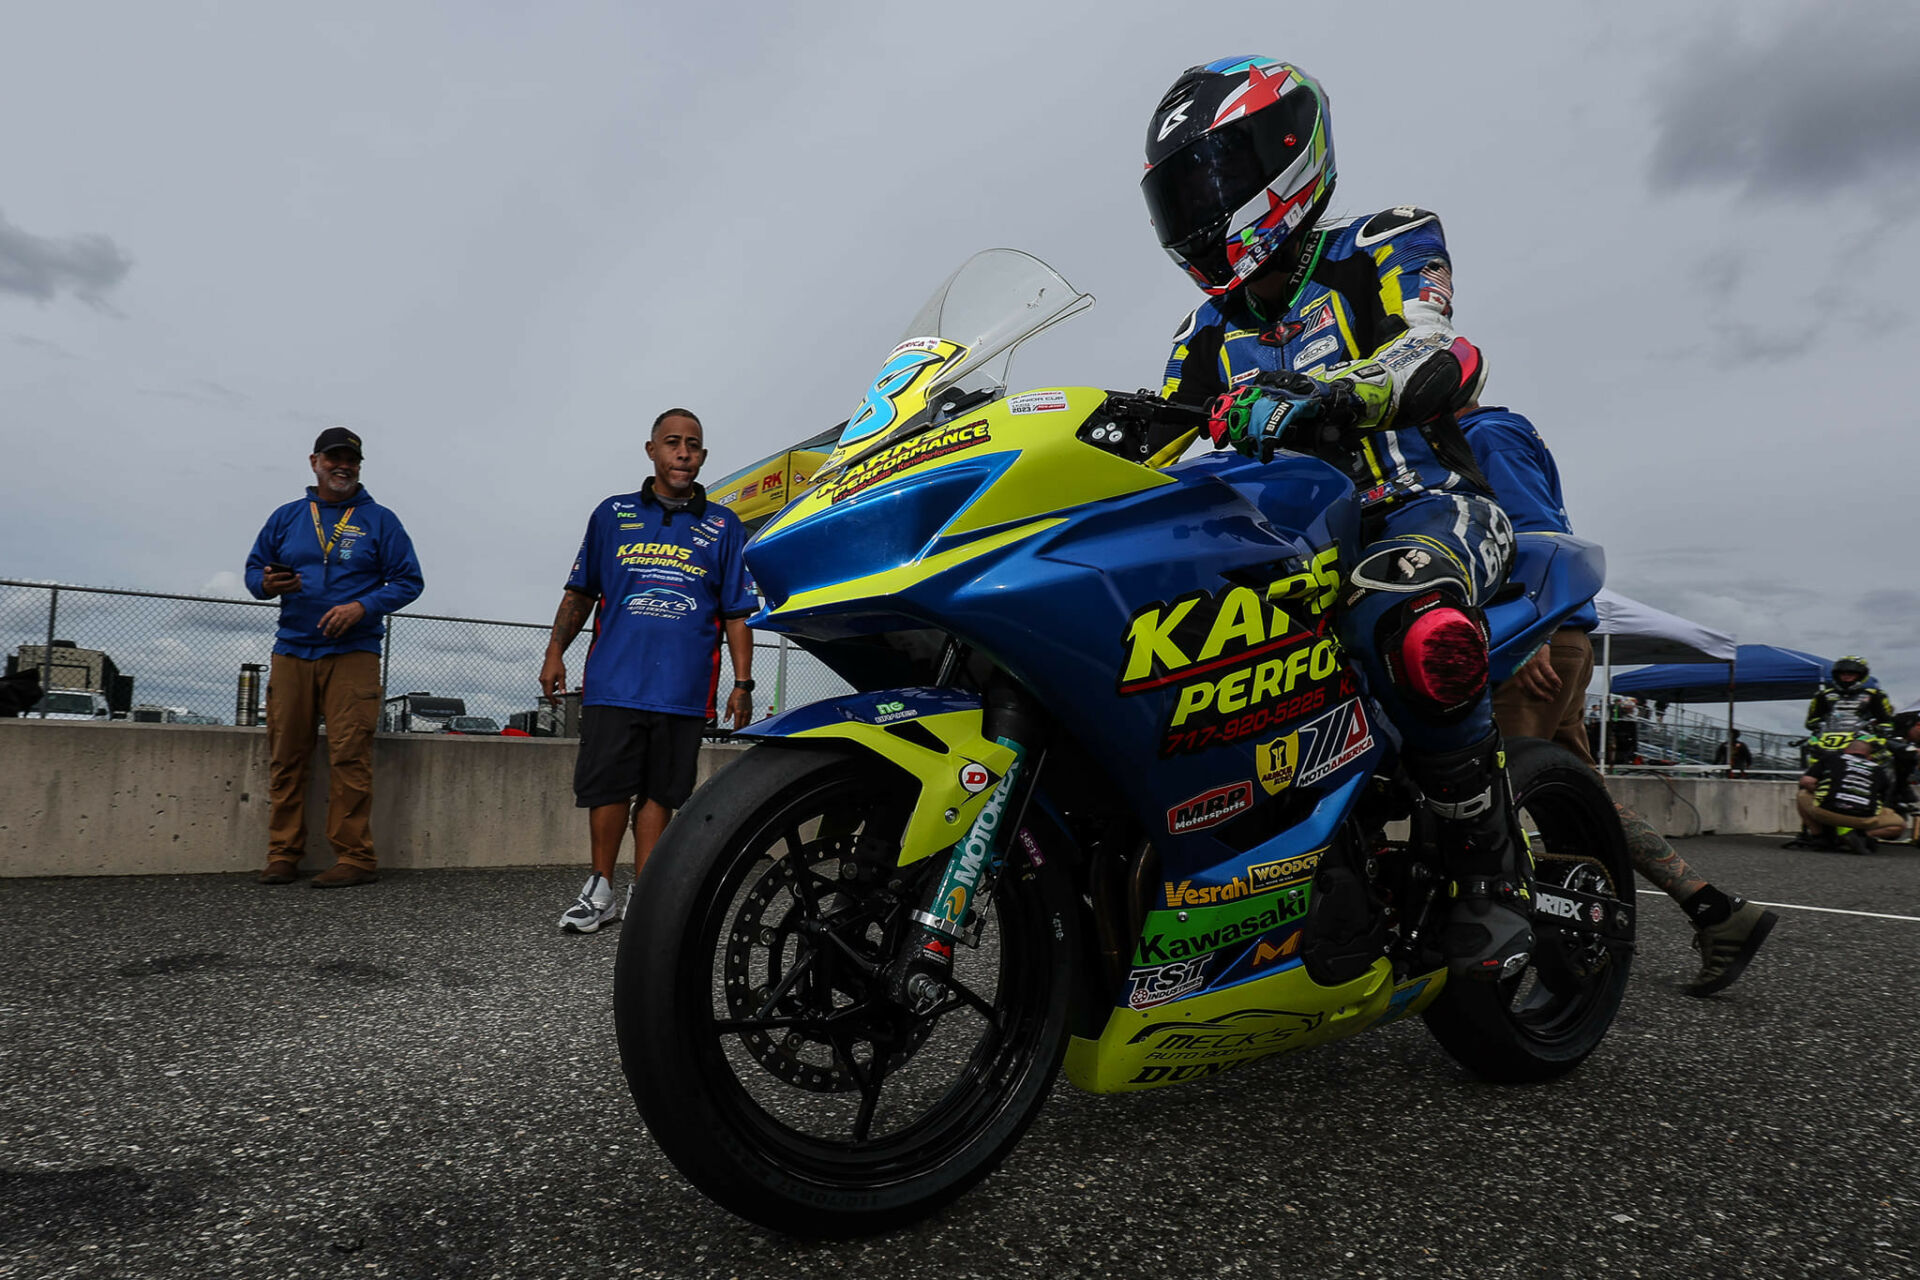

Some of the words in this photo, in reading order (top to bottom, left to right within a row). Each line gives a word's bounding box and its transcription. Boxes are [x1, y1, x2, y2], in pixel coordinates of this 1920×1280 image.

[1011, 406, 1032, 414] 2023
[1265, 401, 1291, 433] BISON
[833, 423, 988, 498] PERFORMANCE
[761, 470, 784, 492] RK
[615, 542, 693, 560] KARNS
[620, 556, 708, 578] PERFORMANCE
[628, 598, 689, 612] MECK'S
[1167, 686, 1326, 753] 717-920-5225
[1261, 765, 1293, 782] ARMOUR
[1300, 738, 1374, 787] MOTOAMERICA
[1175, 800, 1247, 830] Motorsports
[1176, 787, 1246, 823] MRP
[1253, 853, 1322, 881] WOODCR
[1164, 877, 1248, 908] Vesrah
[1139, 889, 1307, 965] Kawasaki
[1128, 952, 1215, 995] TST
[1148, 977, 1203, 1001] INDUSTRIES
[1145, 1051, 1199, 1060] AUTO
